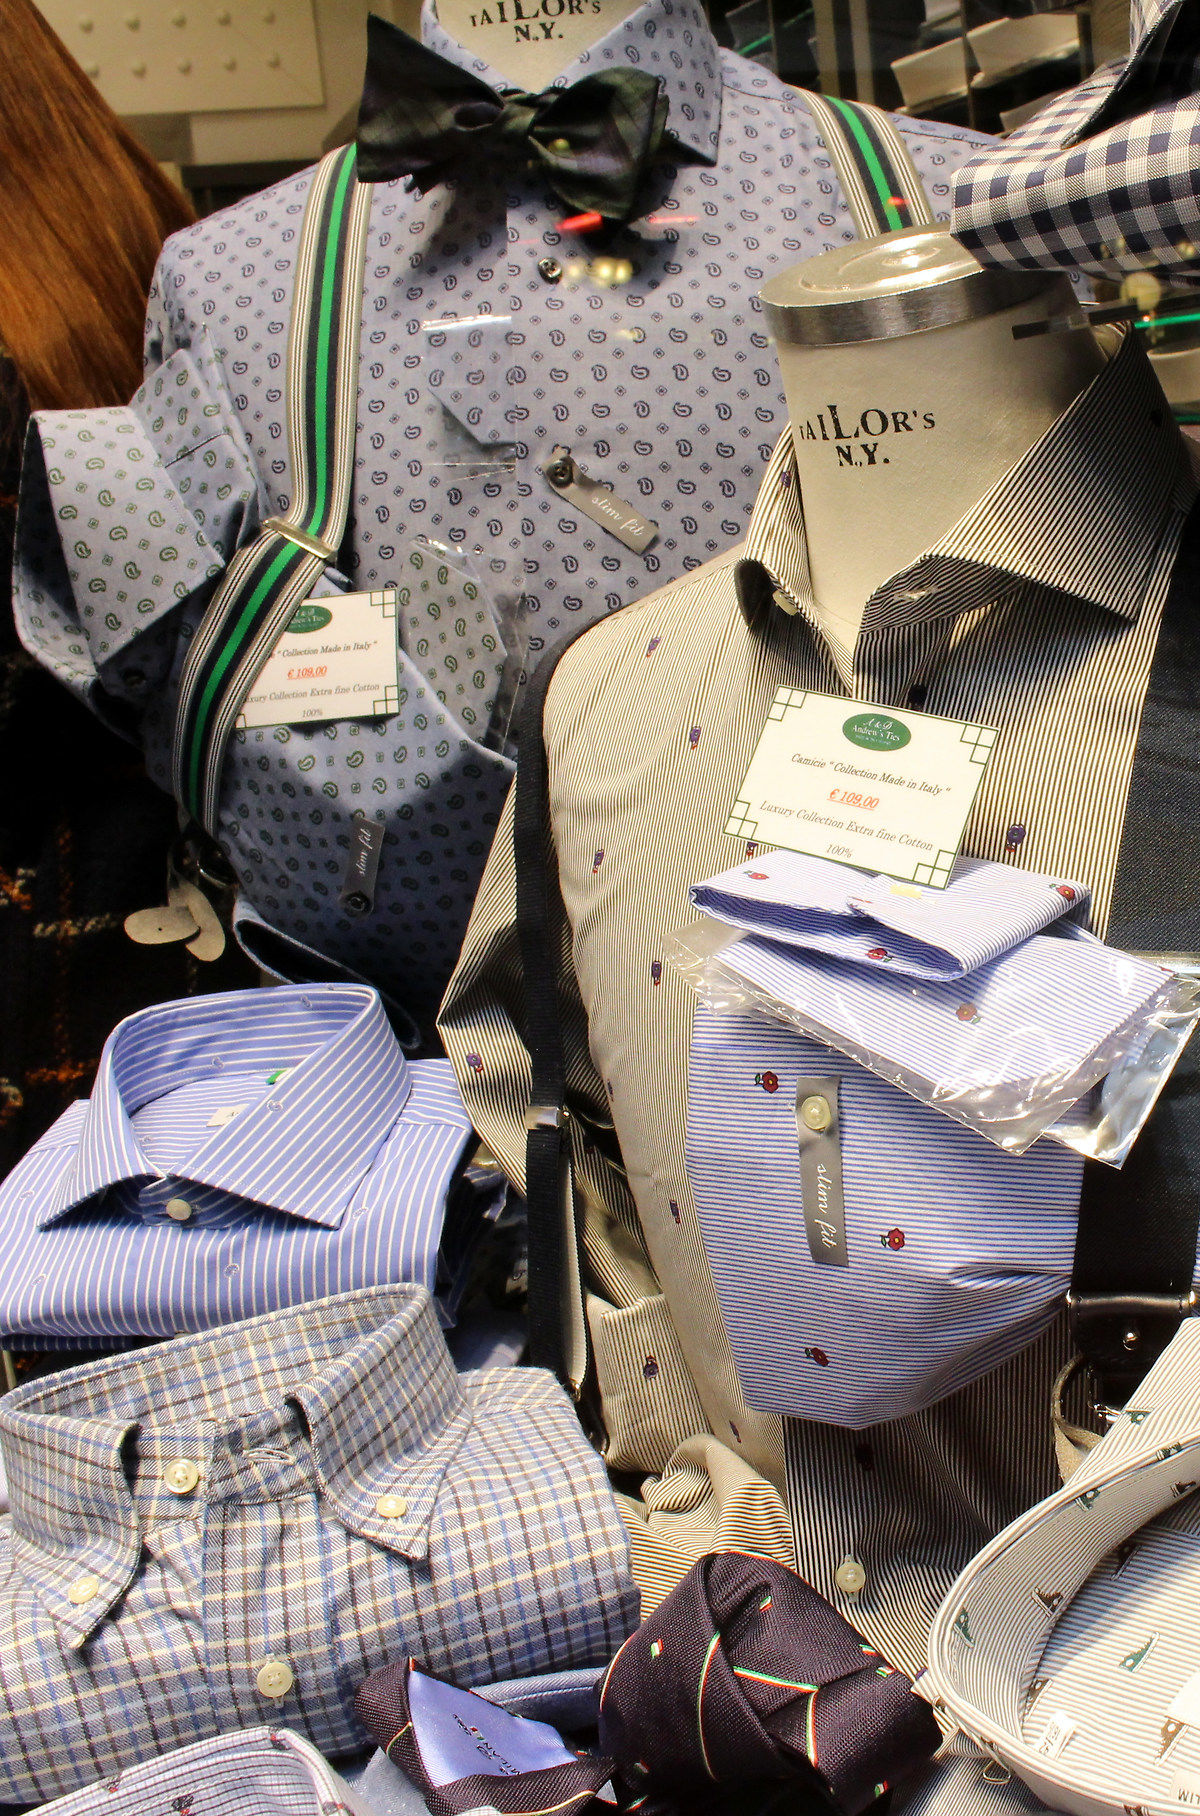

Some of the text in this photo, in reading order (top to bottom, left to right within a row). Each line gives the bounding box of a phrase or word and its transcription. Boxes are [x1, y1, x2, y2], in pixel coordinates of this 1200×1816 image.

[514, 21, 563, 43] N.Y.
[836, 442, 890, 467] N.Y.
[592, 497, 644, 536] slim fit
[320, 644, 341, 654] Made
[343, 643, 351, 652] in
[269, 691, 308, 701] Collection
[310, 688, 332, 698] Extra
[335, 685, 350, 695] fine
[352, 683, 380, 693] Cotton
[302, 708, 323, 718] 100%
[887, 731, 900, 741] Ties
[791, 753, 826, 768] Camicie
[879, 772, 906, 787] Made
[907, 776, 917, 789] in
[829, 788, 880, 809] € 109,00
[759, 800, 934, 852] Luxury Collection Extra fine Cotton
[825, 843, 853, 859] 100%
[814, 1163, 837, 1248] slim fit
